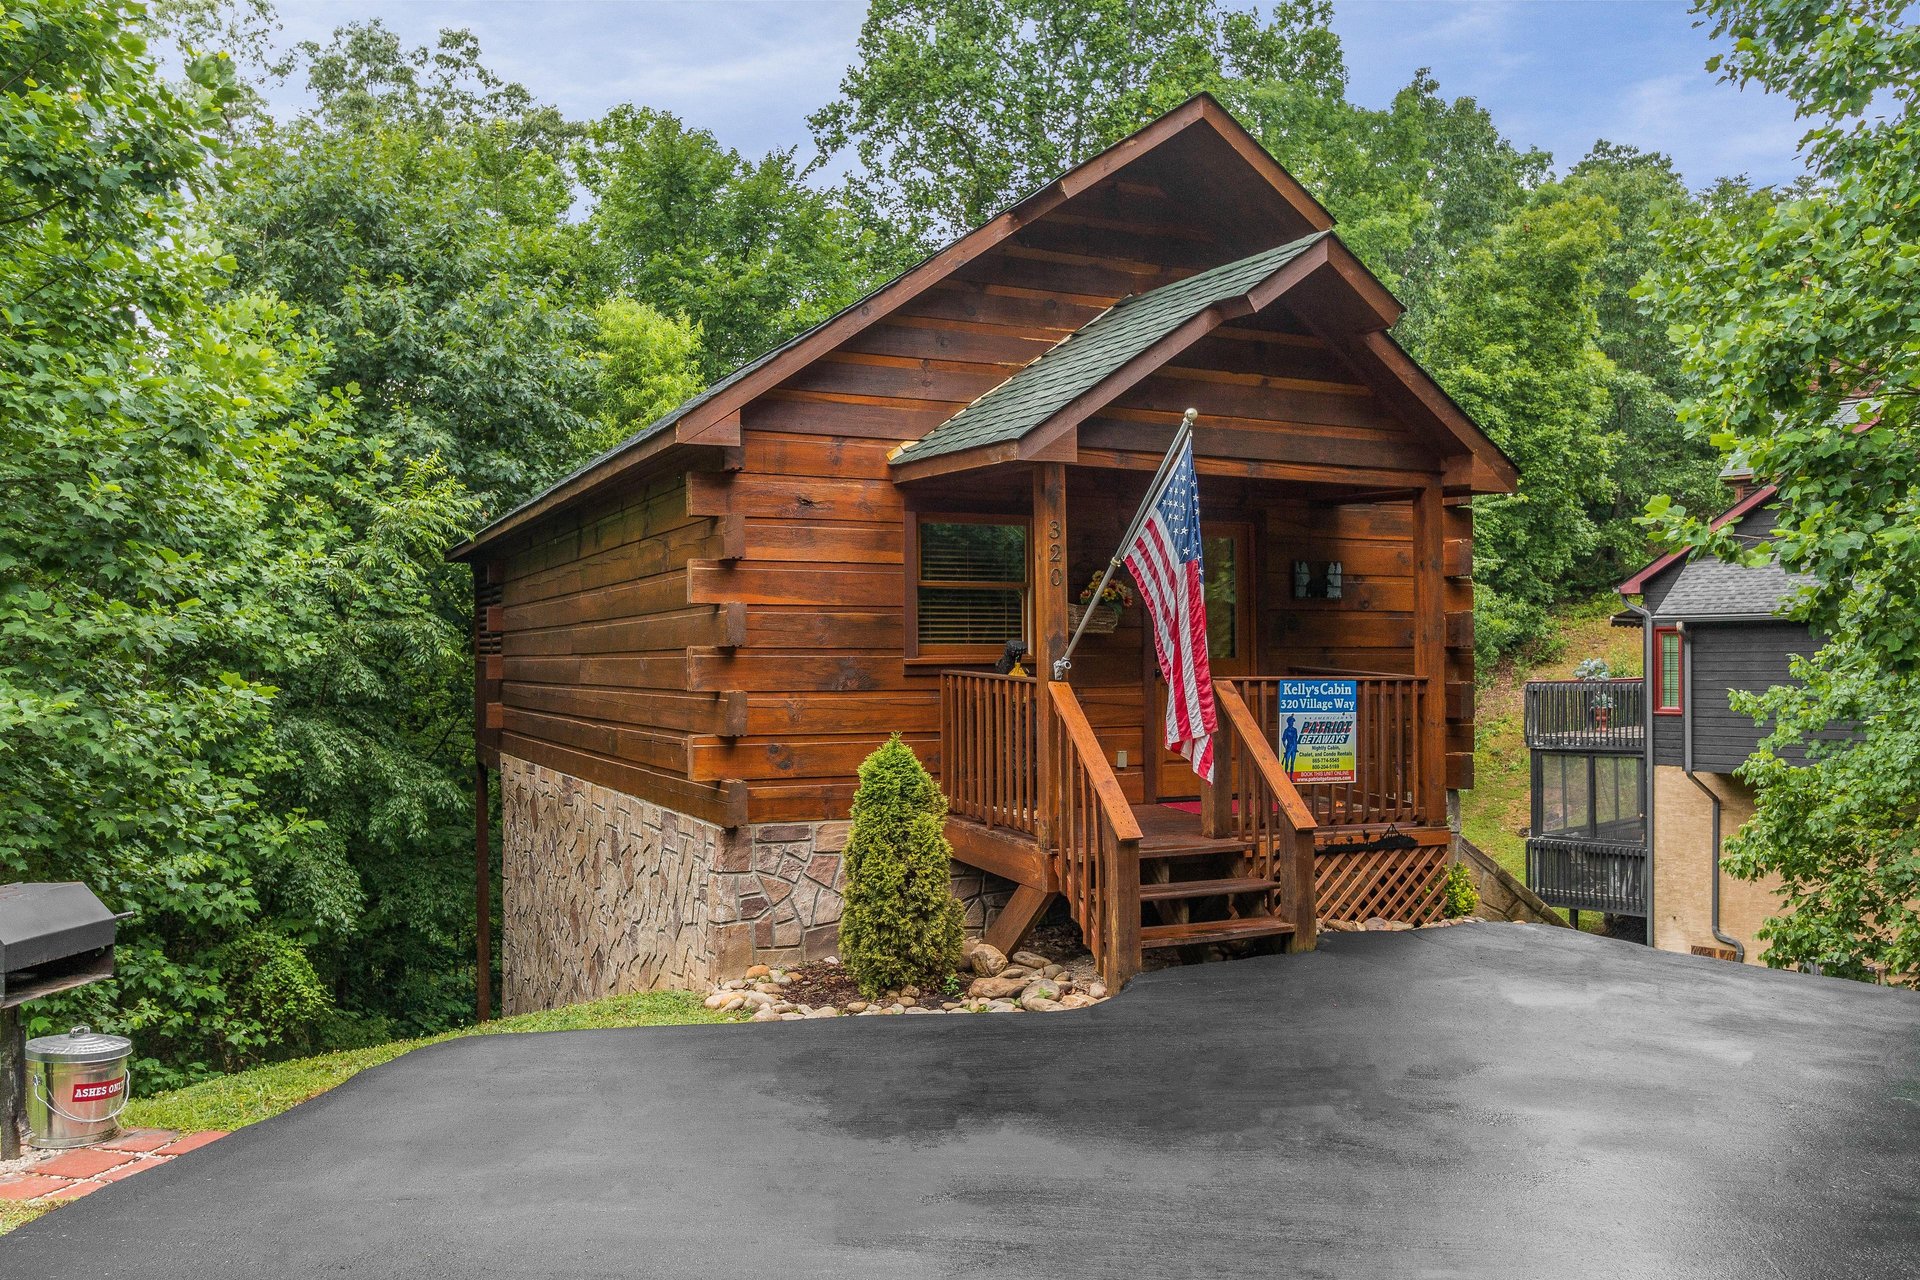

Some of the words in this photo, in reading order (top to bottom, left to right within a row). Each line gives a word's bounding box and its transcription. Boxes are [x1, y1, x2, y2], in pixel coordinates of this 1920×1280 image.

[1049, 520, 1063, 586] 320
[1283, 682, 1319, 697] Kelly's
[1320, 682, 1352, 695] Cabin
[1281, 699, 1298, 709] 320
[1300, 698, 1333, 711] Village
[1334, 698, 1355, 711] Way
[1301, 721, 1353, 734] PATRIOT
[1300, 735, 1346, 744] GETAWAYS
[75, 1086, 107, 1098] ASHES
